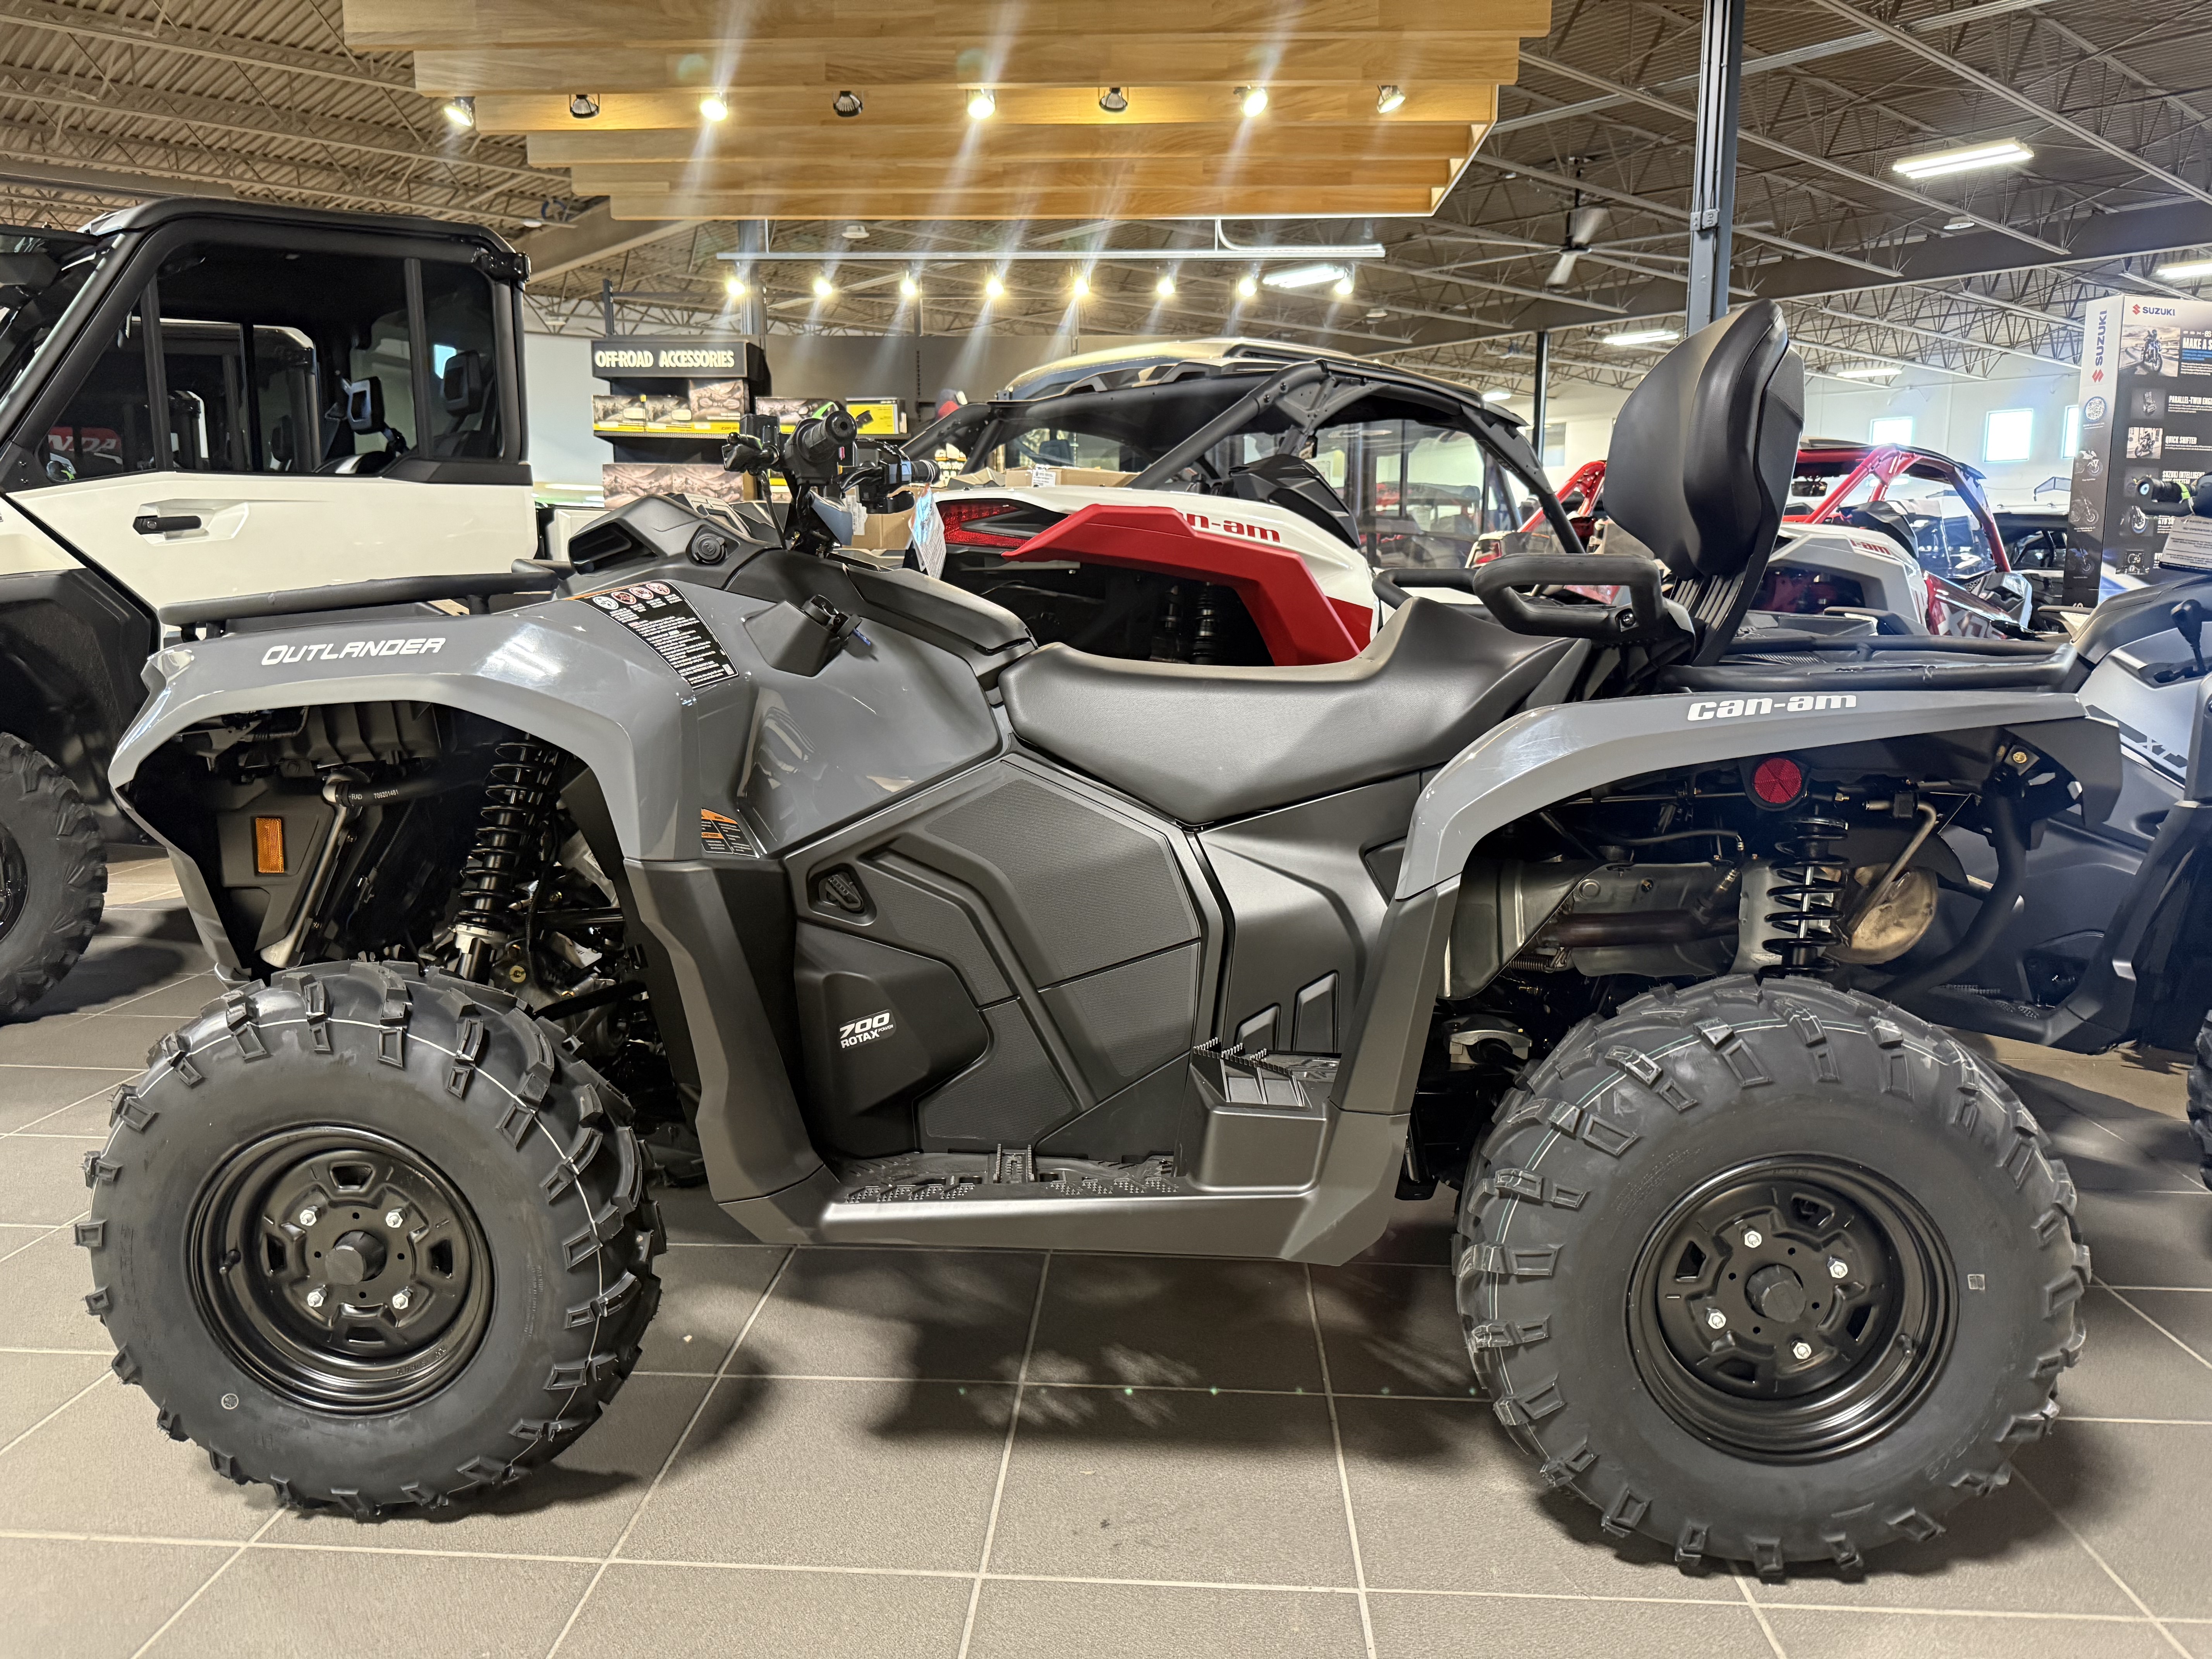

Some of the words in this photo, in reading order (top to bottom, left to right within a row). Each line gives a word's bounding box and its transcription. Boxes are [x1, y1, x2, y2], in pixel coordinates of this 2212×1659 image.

[2142, 306, 2175, 316] SUZUKI
[2095, 310, 2107, 366] SUZUKI
[2182, 337, 2202, 349] MAKE
[2202, 339, 2207, 350] A
[595, 350, 654, 368] OFF-ROAD
[659, 350, 735, 368] ACCESSORIES
[2169, 395, 2202, 404] PARALLEL-TWIN
[48, 434, 117, 452] NDA
[2165, 436, 2179, 444] QUICK
[1180, 512, 1280, 543] n-am
[1850, 539, 1891, 555] -am
[261, 638, 446, 665] OUTLANDER
[1687, 695, 1856, 721] can-am
[374, 789, 399, 799] 709201481
[840, 1012, 890, 1039] 700
[841, 1029, 879, 1048] ROTAX
[878, 1024, 894, 1032] POWER
